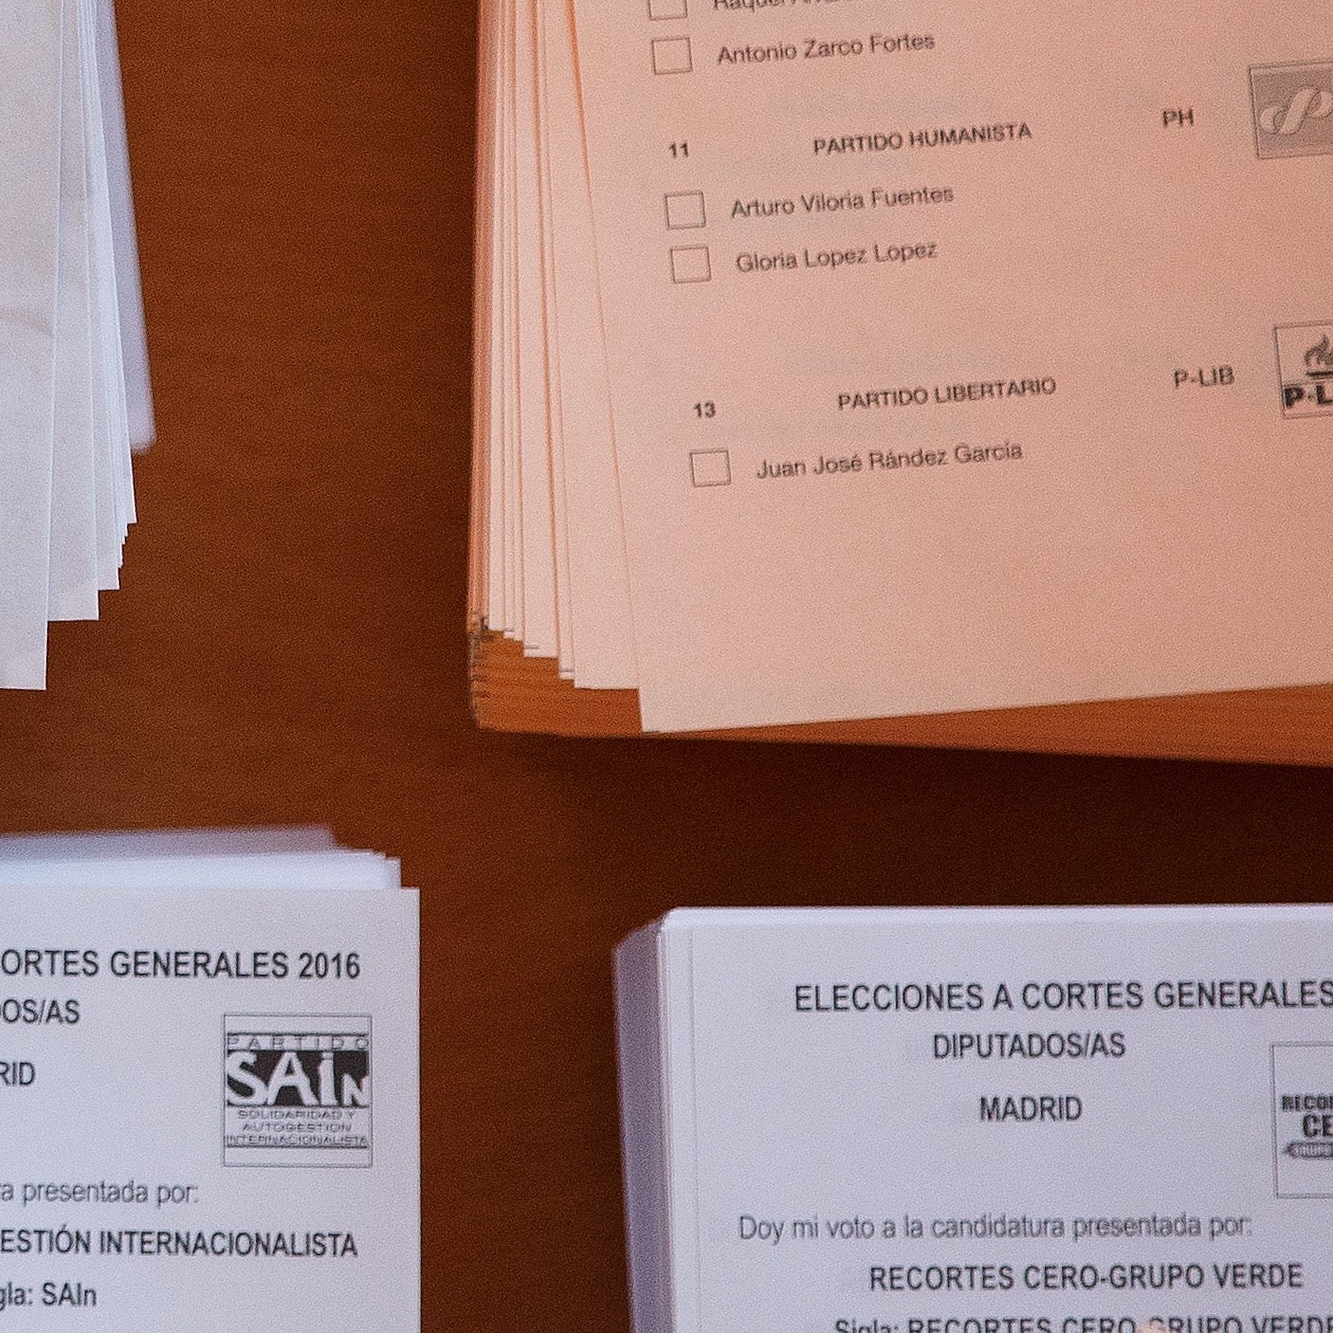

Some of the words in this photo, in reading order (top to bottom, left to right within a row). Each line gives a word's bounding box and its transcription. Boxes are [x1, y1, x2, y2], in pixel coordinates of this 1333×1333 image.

[1161, 107, 1195, 128] PH
[812, 131, 904, 155] PARTIDO
[907, 121, 1033, 148] HUMANISTA
[836, 386, 930, 410] PARTIDO
[933, 375, 1058, 405] LIBERTARIO
[1172, 365, 1236, 389] P-LIB
[108, 949, 290, 981] GENERALES
[297, 950, 362, 981] 2016
[794, 981, 985, 1013] ELECCIONES
[991, 982, 1014, 1010] A
[1020, 979, 1145, 1012] CORTES
[931, 1030, 1127, 1061] DIPUTADOS/AS
[978, 1094, 1084, 1123] MADRID
[98, 1228, 360, 1259] INTERNACIONALISTA
[868, 1263, 1016, 1292] RECORTES
[1022, 1261, 1206, 1291] CERO-GRUPO
[1211, 1261, 1304, 1291] VERDE
[40, 1279, 98, 1308] SAIn
